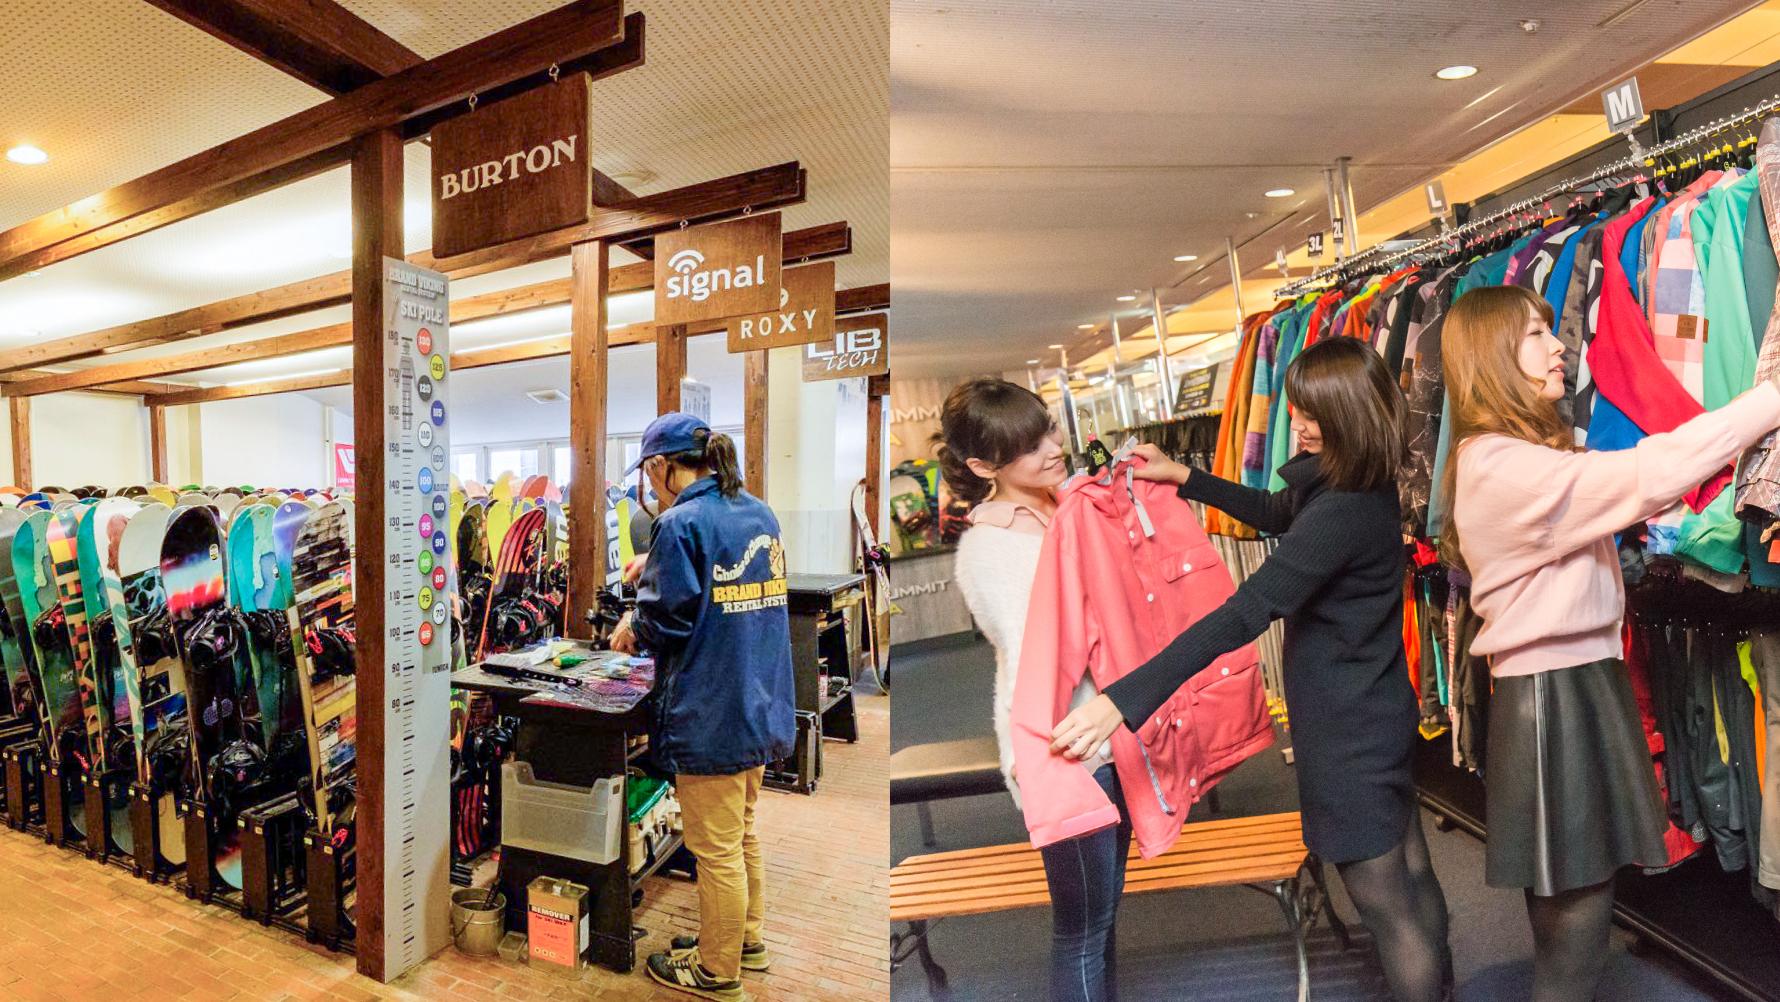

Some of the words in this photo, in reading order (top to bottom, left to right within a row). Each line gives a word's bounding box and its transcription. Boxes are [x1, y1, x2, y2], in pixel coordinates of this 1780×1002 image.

[1607, 85, 1636, 124] M
[440, 134, 577, 200] BURTON
[1427, 185, 1443, 208] L
[1333, 224, 1344, 238] 2L
[1309, 236, 1323, 252] 3L
[666, 250, 765, 300] signal
[400, 301, 417, 318] SKI
[418, 305, 443, 324] POLE
[741, 309, 816, 339] ROXY
[808, 328, 882, 358] LIB
[822, 350, 878, 370] TECH
[388, 368, 399, 378] 170
[389, 443, 399, 452] 150
[389, 480, 399, 489] 140
[420, 476, 431, 485] 100
[389, 517, 399, 526] 130
[421, 522, 431, 531] 95
[435, 538, 444, 547] 90
[390, 554, 400, 563] 120
[435, 575, 444, 583] 80
[422, 594, 430, 602] 75
[713, 583, 761, 603] BRAND
[436, 609, 444, 617] 70
[390, 627, 400, 637] 100
[392, 663, 400, 673] 90
[392, 698, 400, 709] 80
[531, 905, 571, 921] REMOVER
